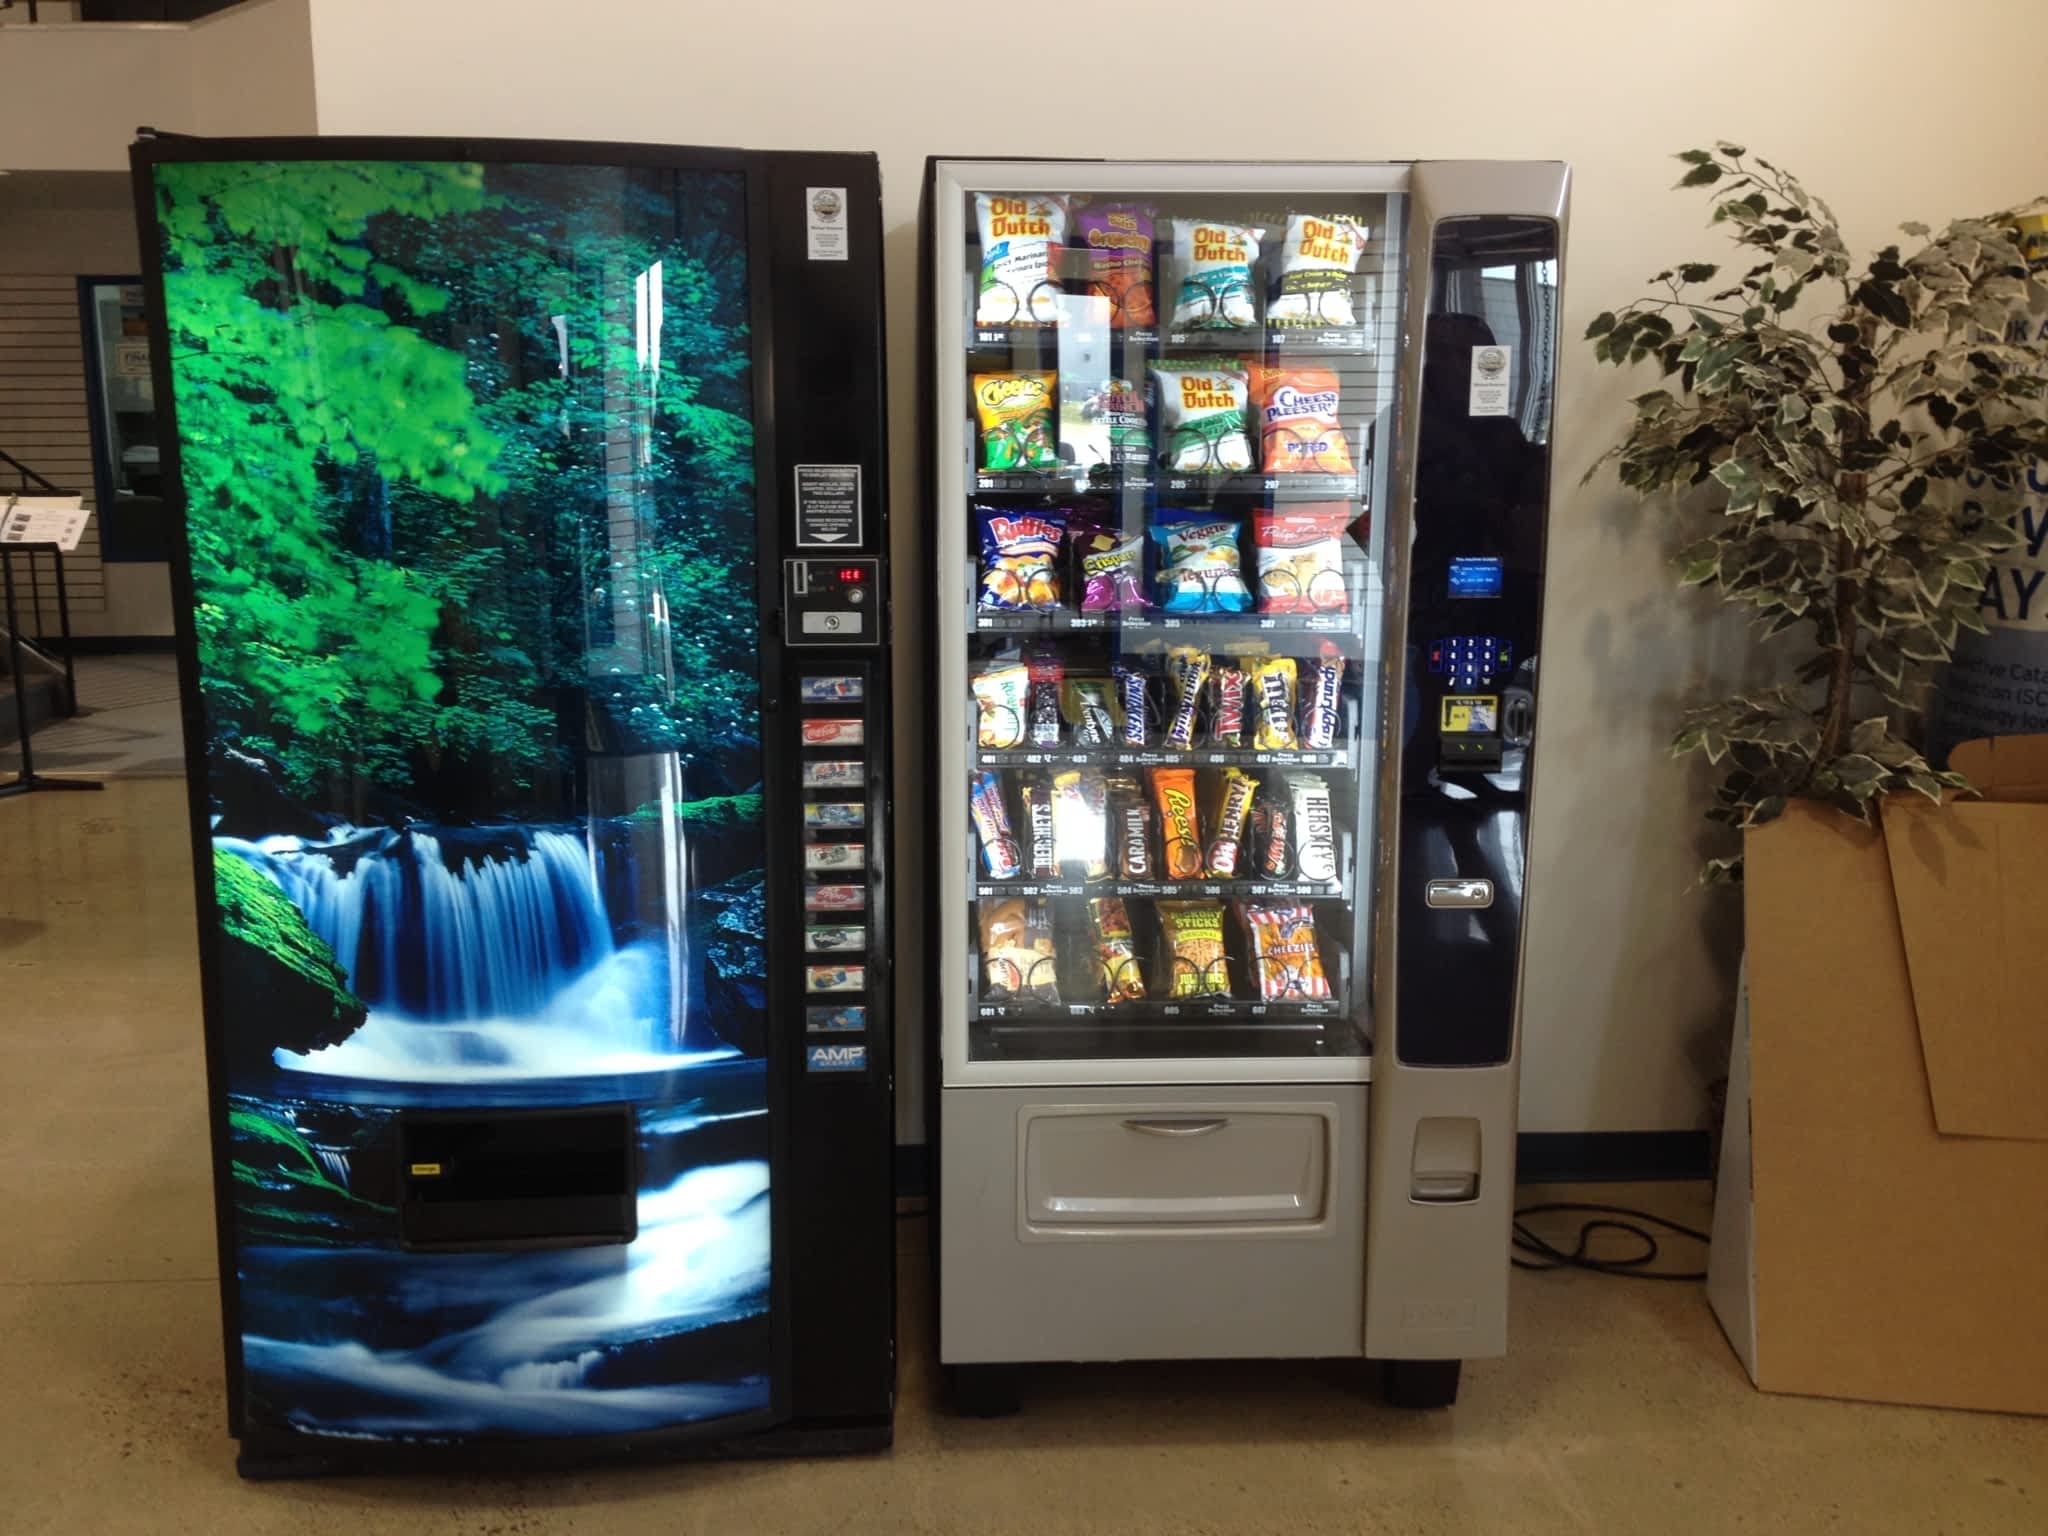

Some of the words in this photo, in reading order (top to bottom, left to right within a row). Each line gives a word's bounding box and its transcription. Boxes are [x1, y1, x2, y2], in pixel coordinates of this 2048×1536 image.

[991, 198, 1027, 216] Old
[992, 217, 1050, 237] Dutch
[1194, 228, 1226, 244] Old
[1303, 220, 1335, 240] Old
[1194, 245, 1247, 262] Dutch
[1300, 239, 1349, 264] Dutch
[1181, 376, 1213, 391] Old
[1183, 392, 1235, 409] Dutch
[988, 516, 1064, 545] Ruffles
[1215, 670, 1243, 741] TWIX
[1126, 808, 1147, 874] CARAMILK
[1175, 918, 1220, 929] STICKS
[811, 1047, 865, 1061] AMP
